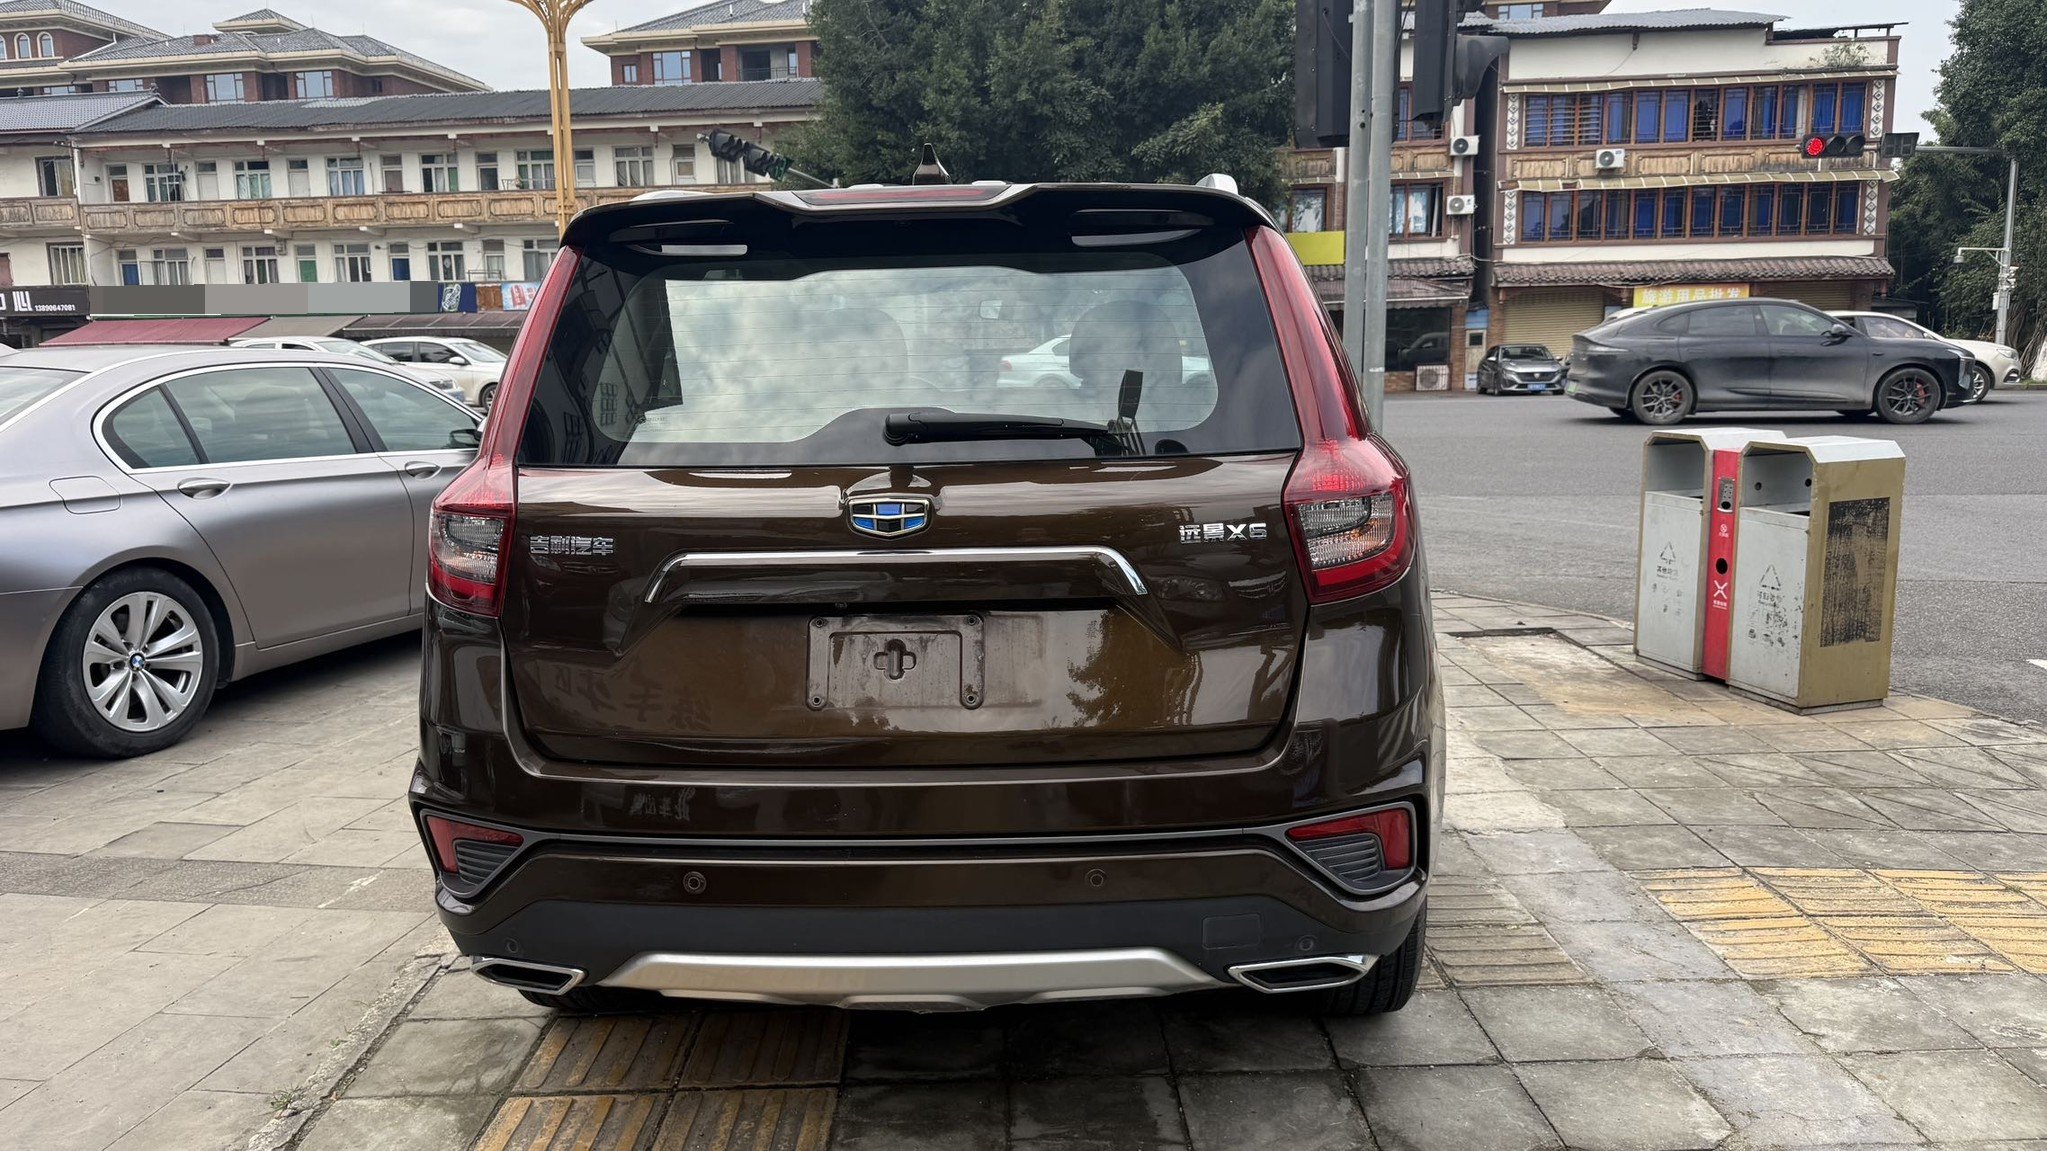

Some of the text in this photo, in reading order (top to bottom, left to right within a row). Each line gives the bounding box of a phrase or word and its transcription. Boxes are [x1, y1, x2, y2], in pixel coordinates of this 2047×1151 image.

[1642, 287, 1741, 304] 旅游用品批发
[530, 535, 614, 555] 吉利汽车
